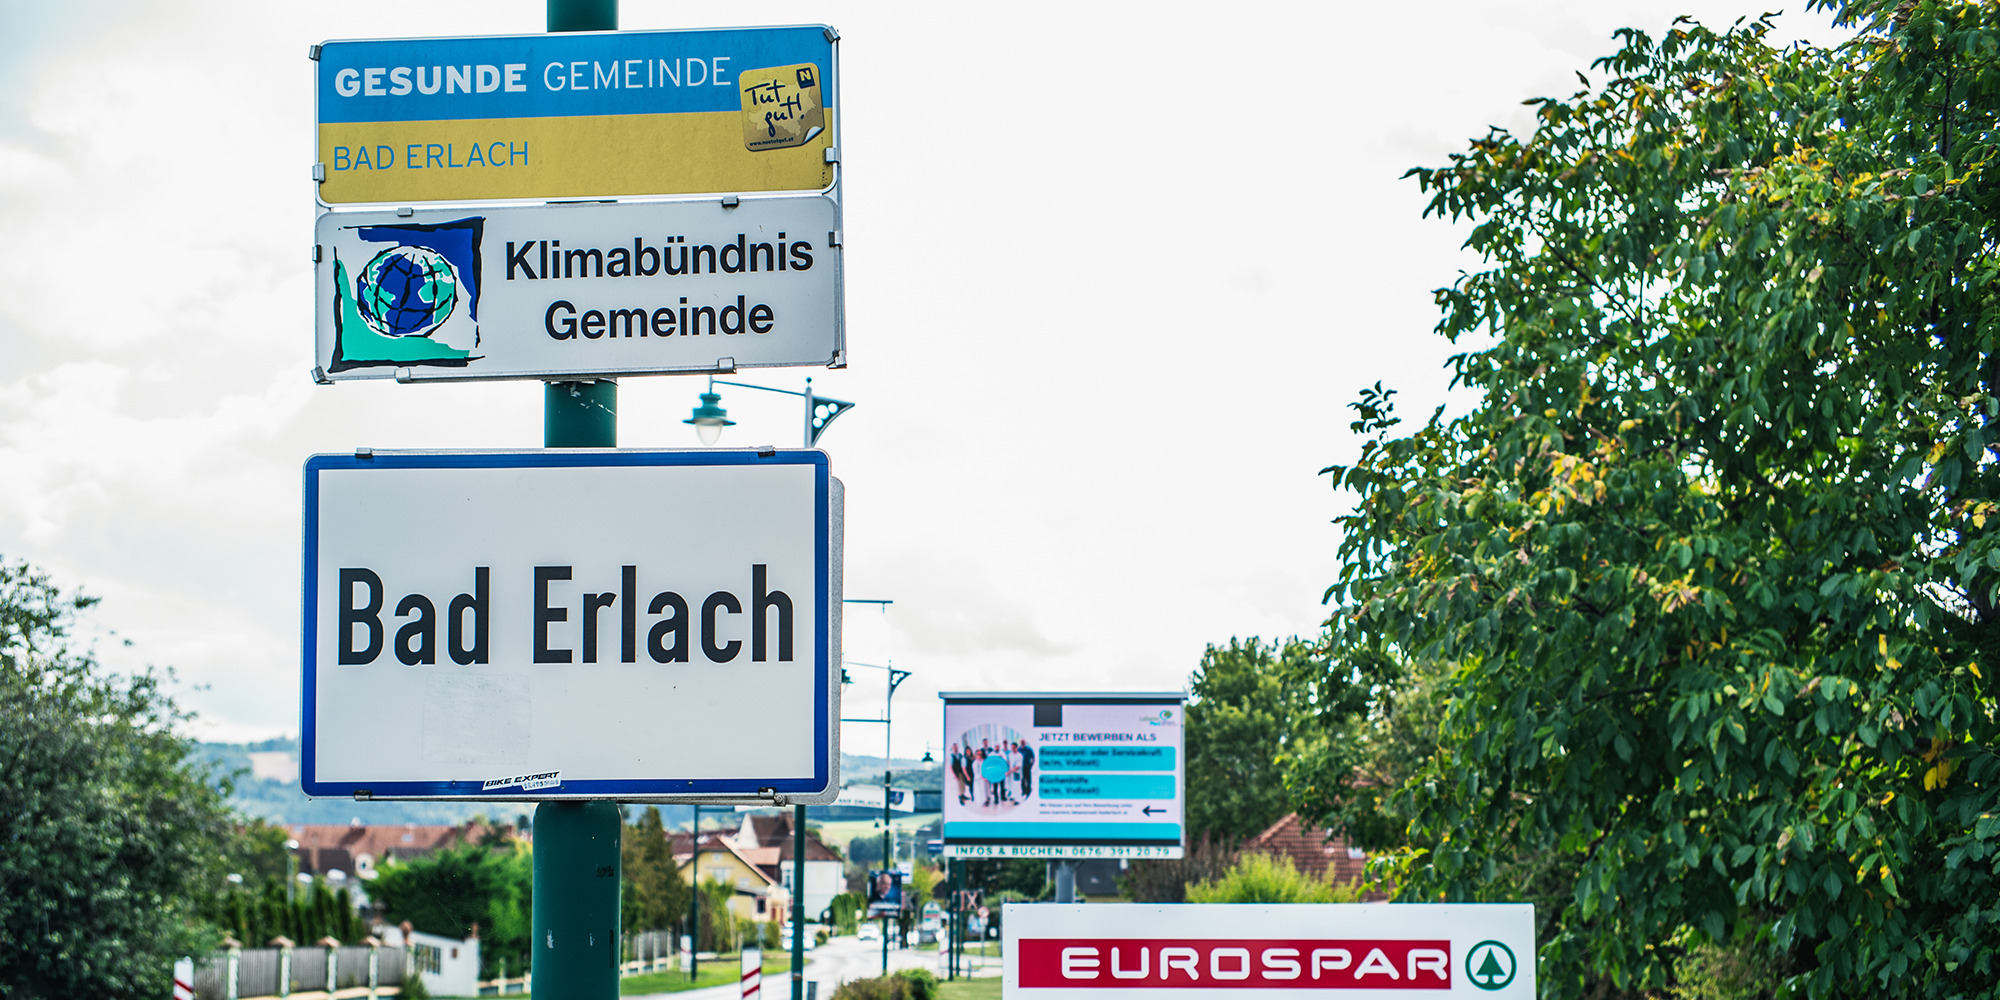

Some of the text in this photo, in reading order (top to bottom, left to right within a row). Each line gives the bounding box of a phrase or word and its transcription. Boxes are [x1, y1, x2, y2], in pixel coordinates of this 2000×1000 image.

[334, 56, 731, 98] GESUNDE GEMEINDE
[744, 79, 786, 105] Tut
[765, 93, 805, 137] gut!
[333, 141, 529, 172] BAD ERLACH
[505, 232, 814, 281] Klimabündnis
[544, 296, 774, 340] Gemeinde
[338, 564, 794, 666] Bad Erlach
[1039, 733, 1157, 741] JETZT BEWERBEN ALS
[1091, 748, 1109, 757] oder
[485, 777, 512, 787] BIKE
[514, 771, 560, 783] EXPERT
[956, 846, 993, 856] INFOS
[998, 847, 1006, 856] &
[1012, 847, 1068, 856] BUCHEN:
[1110, 847, 1131, 857] 391
[1137, 847, 1151, 857] 20
[1156, 847, 1170, 857] 79
[1061, 946, 1449, 981] EUROSPAR
